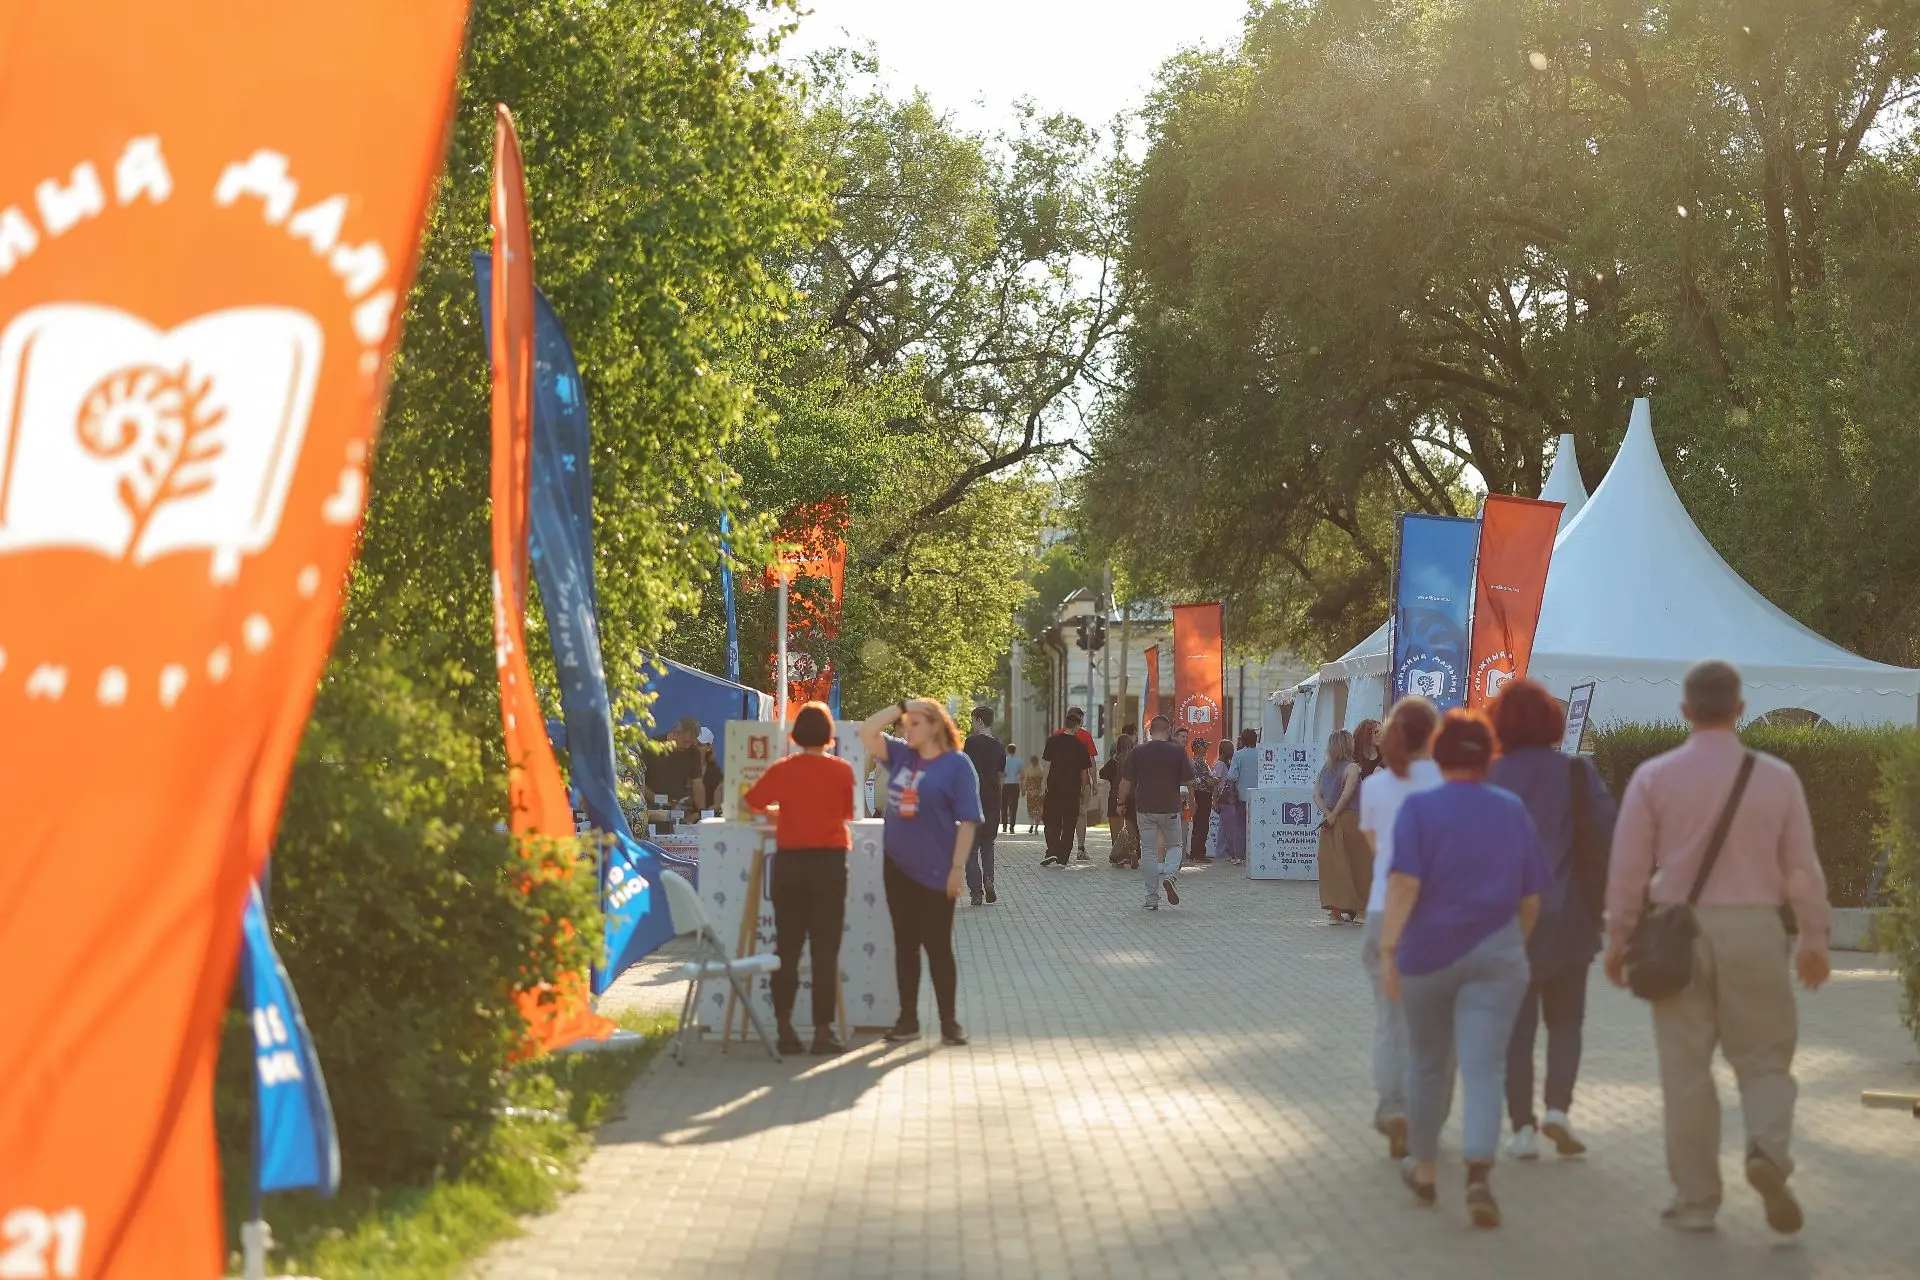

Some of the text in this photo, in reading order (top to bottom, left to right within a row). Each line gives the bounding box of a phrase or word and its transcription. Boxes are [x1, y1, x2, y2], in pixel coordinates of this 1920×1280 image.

[1398, 653, 1458, 693] КНИЖНЫЙ ДАЛЬНИЙ
[1474, 650, 1506, 691] КНИЖНЫЙ
[0, 1205, 86, 1277] 21
